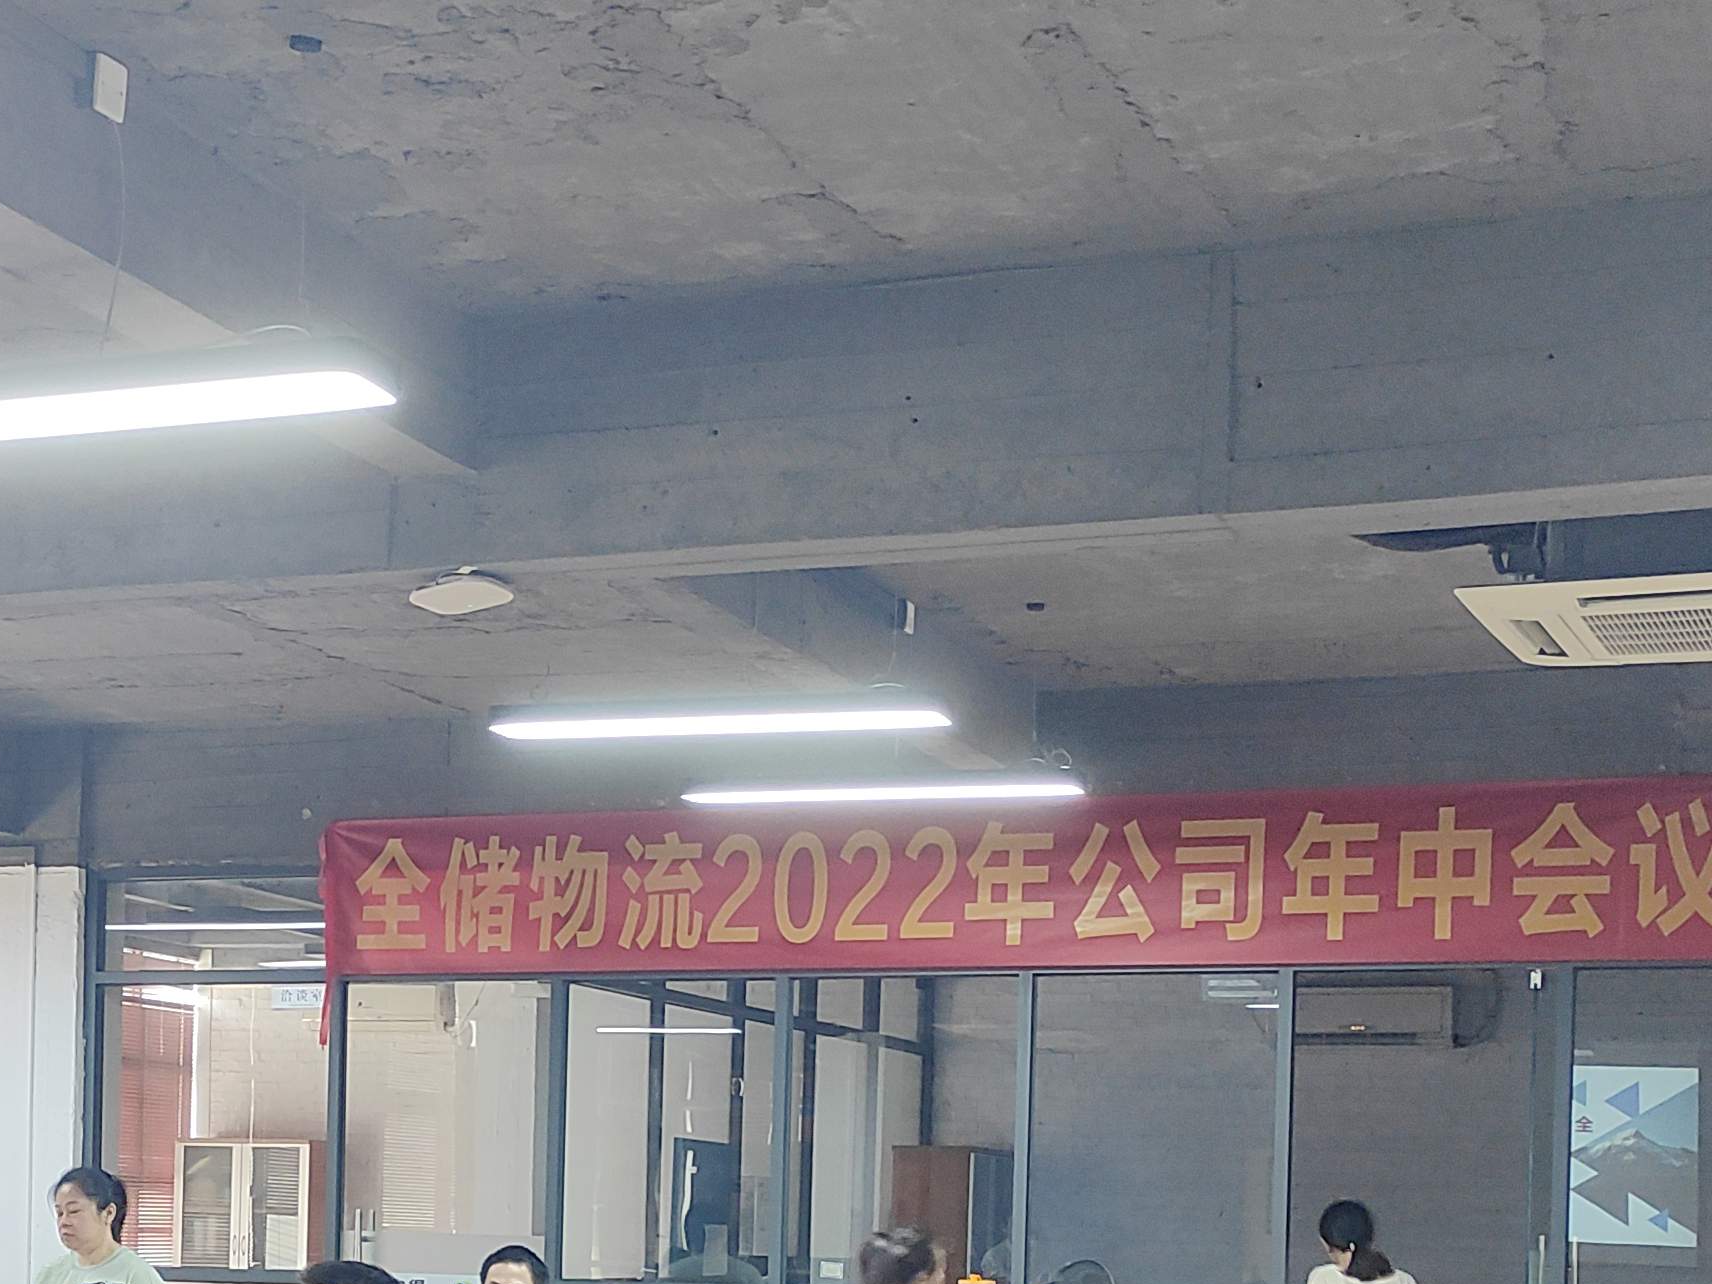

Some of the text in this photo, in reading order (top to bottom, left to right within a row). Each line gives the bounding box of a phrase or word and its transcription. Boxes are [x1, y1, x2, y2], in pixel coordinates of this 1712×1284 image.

[354, 799, 1712, 953] 全储物流2022年公司年中会议
